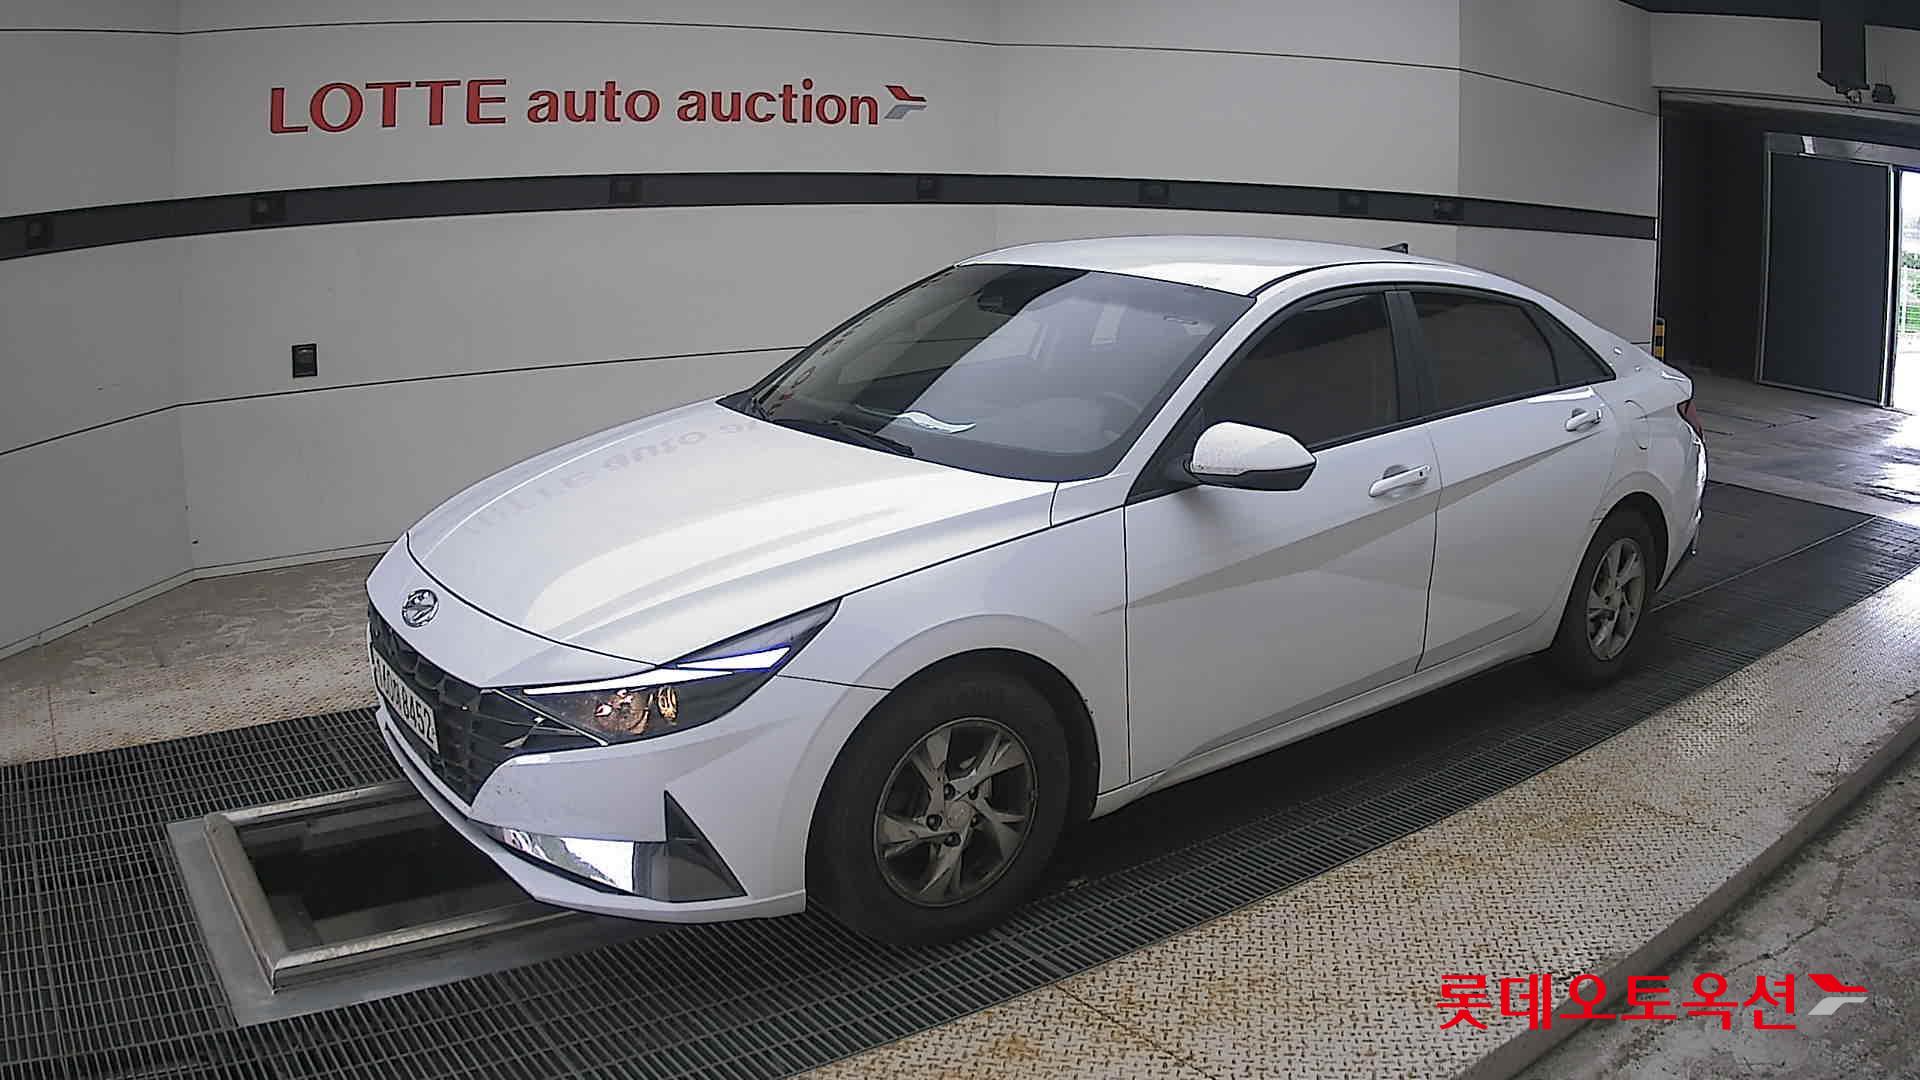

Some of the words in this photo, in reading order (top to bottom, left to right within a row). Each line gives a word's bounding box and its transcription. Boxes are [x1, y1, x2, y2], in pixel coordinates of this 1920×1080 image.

[270, 79, 505, 134] LOTTE
[527, 80, 660, 124] auto
[677, 79, 878, 126] auction
